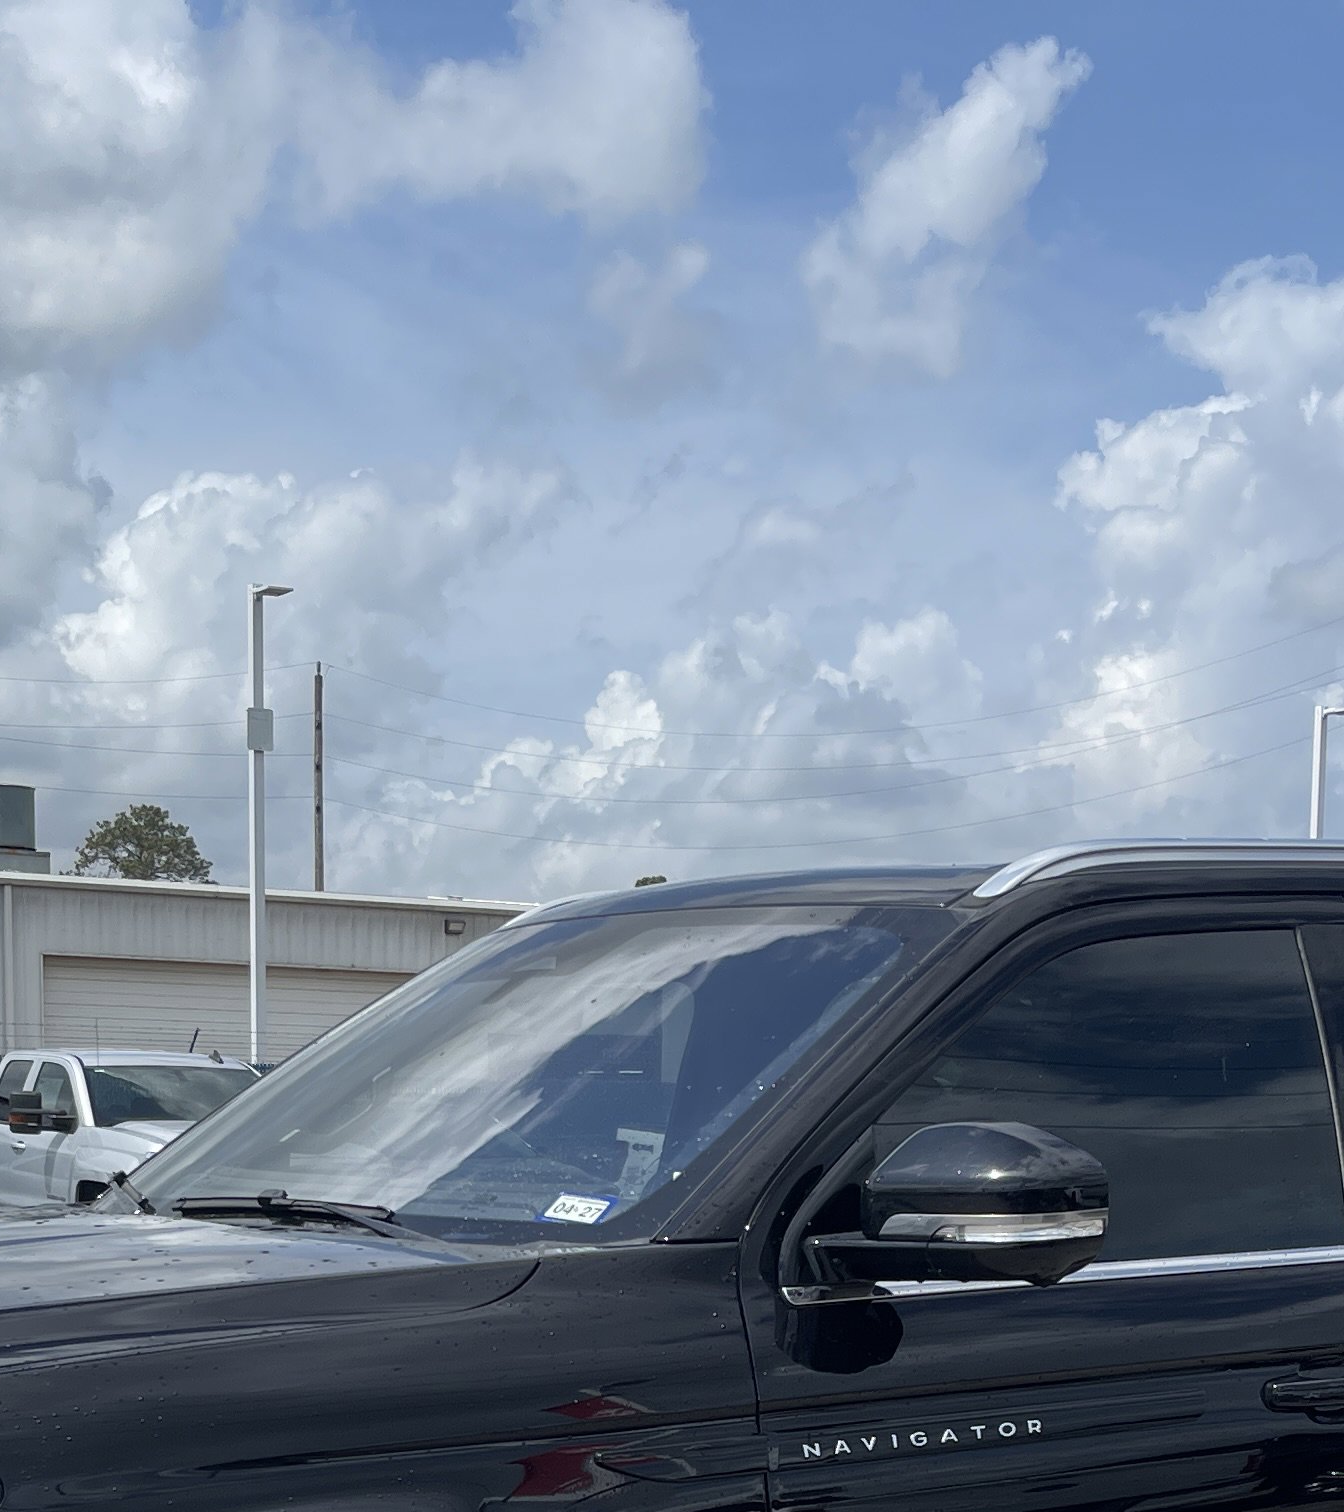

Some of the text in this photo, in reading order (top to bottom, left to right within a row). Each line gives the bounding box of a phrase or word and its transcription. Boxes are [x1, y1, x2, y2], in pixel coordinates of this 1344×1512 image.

[552, 1202, 603, 1218] 04 27
[802, 1419, 1043, 1458] NAVIGATOR
